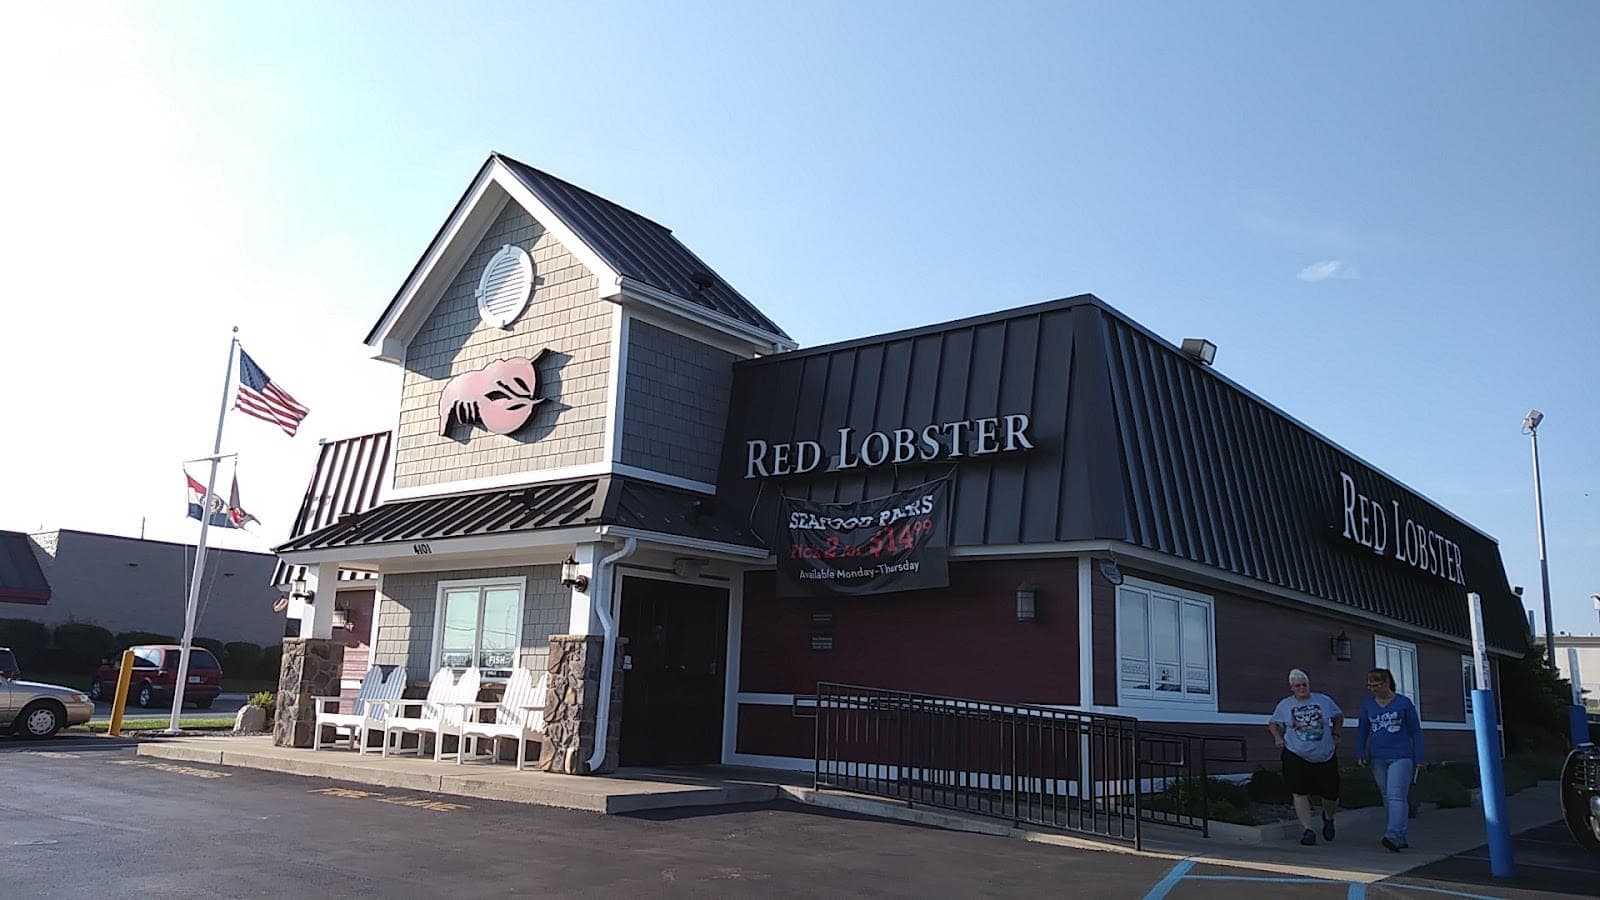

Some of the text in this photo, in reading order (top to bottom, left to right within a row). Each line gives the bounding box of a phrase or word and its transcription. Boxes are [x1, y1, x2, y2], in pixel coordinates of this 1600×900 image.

[745, 414, 1035, 479] RED LOBSTER
[788, 511, 874, 530] SEAFOOD
[1340, 471, 1466, 586] RED LOBSTER
[413, 543, 432, 555] 4101
[799, 560, 920, 580] Available Monday-Thursday
[489, 656, 506, 665] FISH
